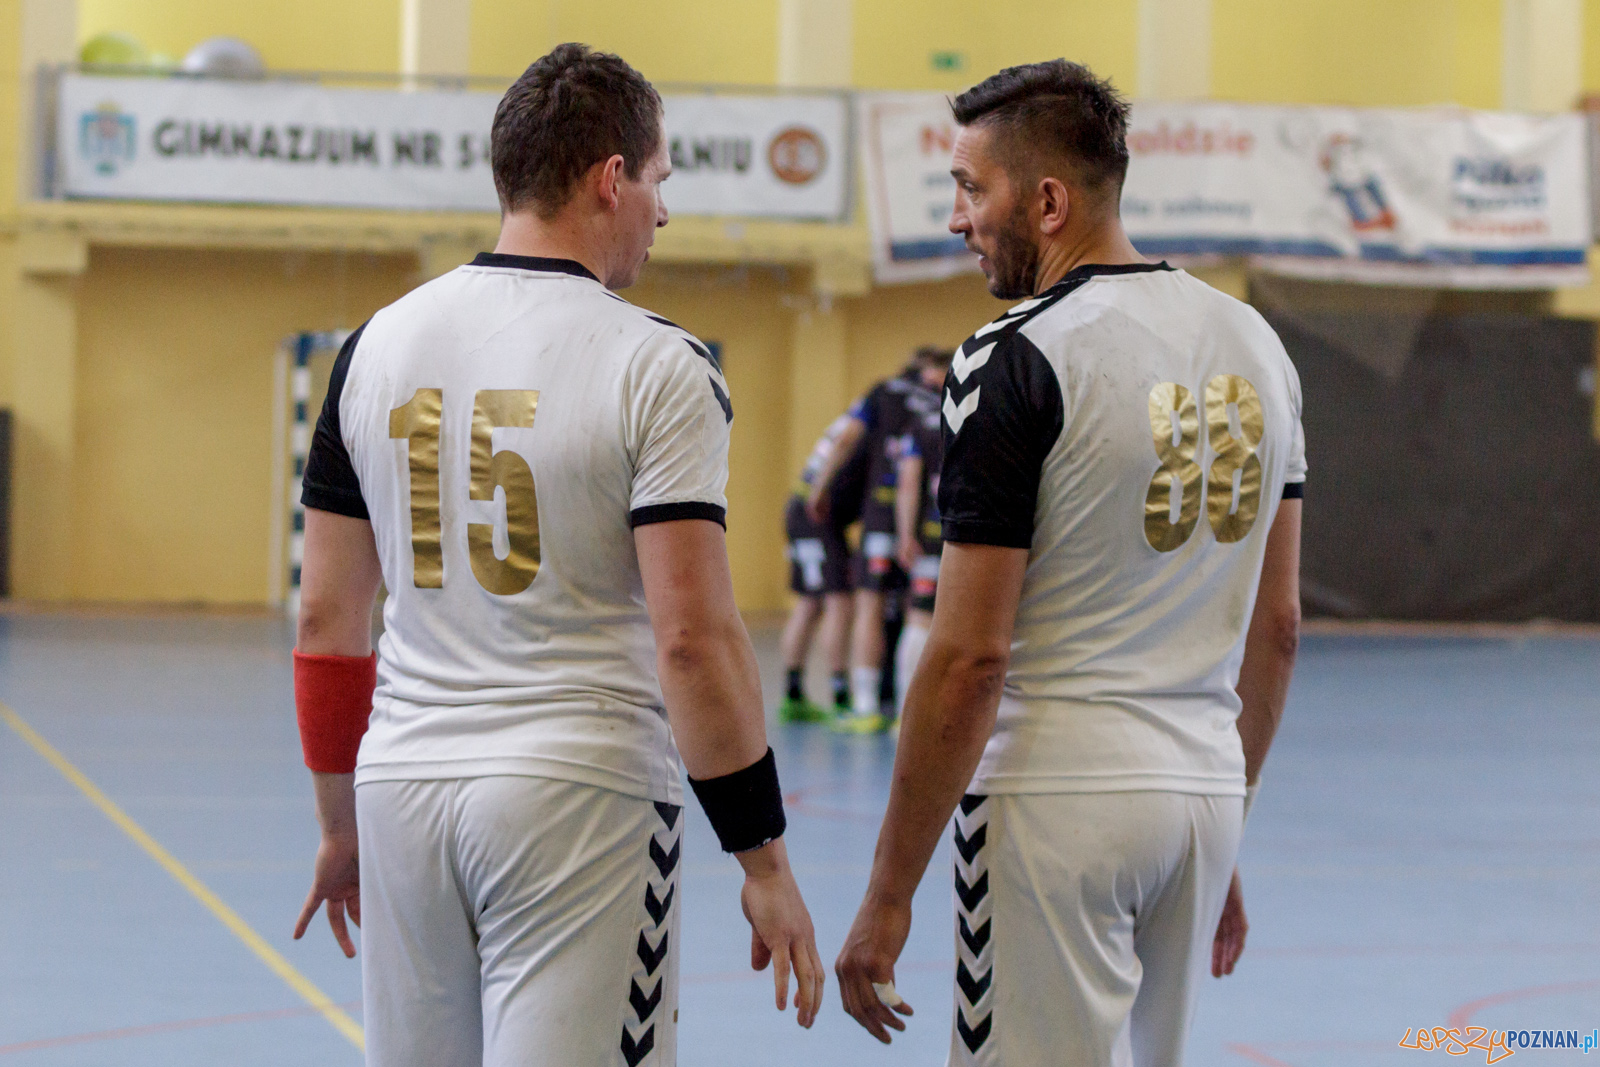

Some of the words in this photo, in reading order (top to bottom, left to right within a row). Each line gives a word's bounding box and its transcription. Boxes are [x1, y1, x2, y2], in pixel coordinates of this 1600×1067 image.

[153, 118, 378, 166] GIMNAZJUM
[393, 130, 442, 167] NR
[671, 134, 753, 173] ANIU
[389, 388, 542, 596] 15
[1144, 374, 1264, 553] 88
